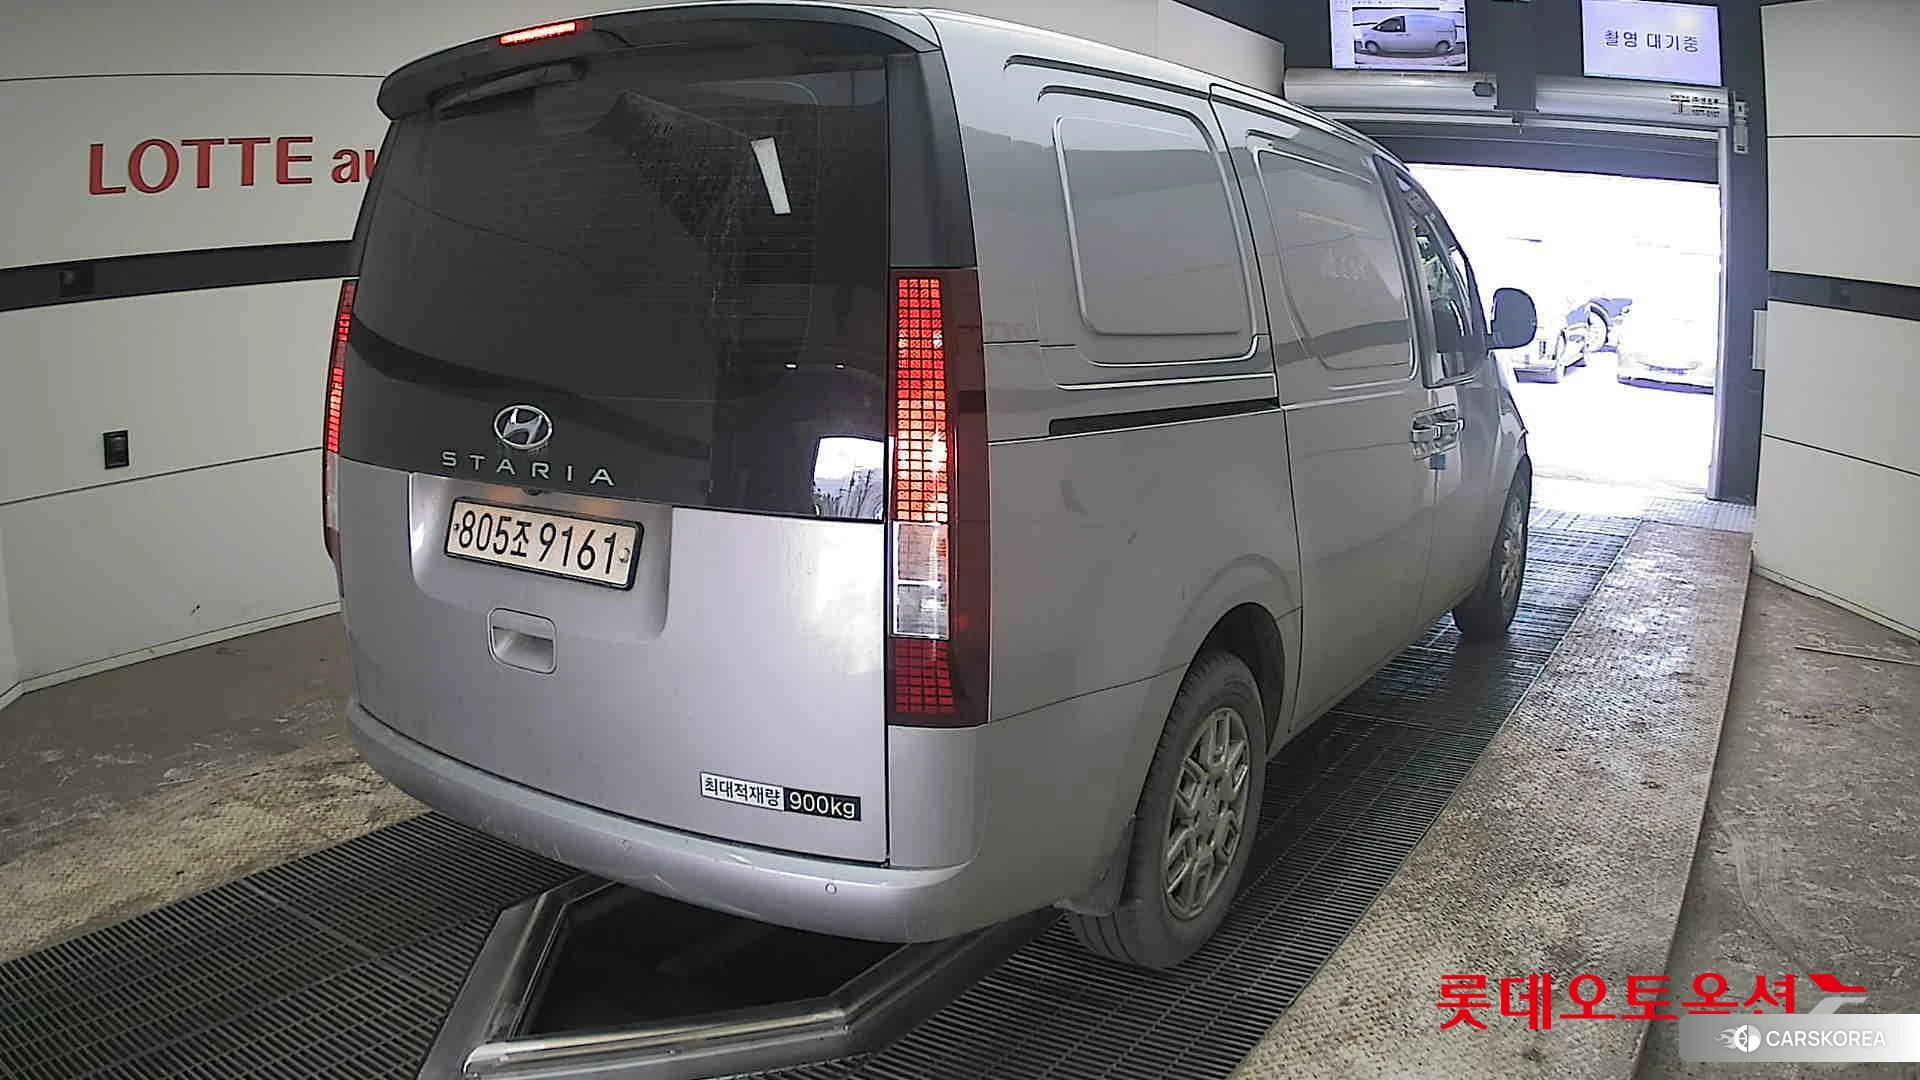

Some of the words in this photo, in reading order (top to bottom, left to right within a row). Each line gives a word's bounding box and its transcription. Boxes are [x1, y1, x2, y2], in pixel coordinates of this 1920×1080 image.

[1646, 33, 1698, 52] 대기중
[89, 136, 313, 195] LOTTE
[442, 451, 616, 487] STARIA
[704, 777, 781, 807] 최대적재량
[789, 791, 856, 819] 900kg
